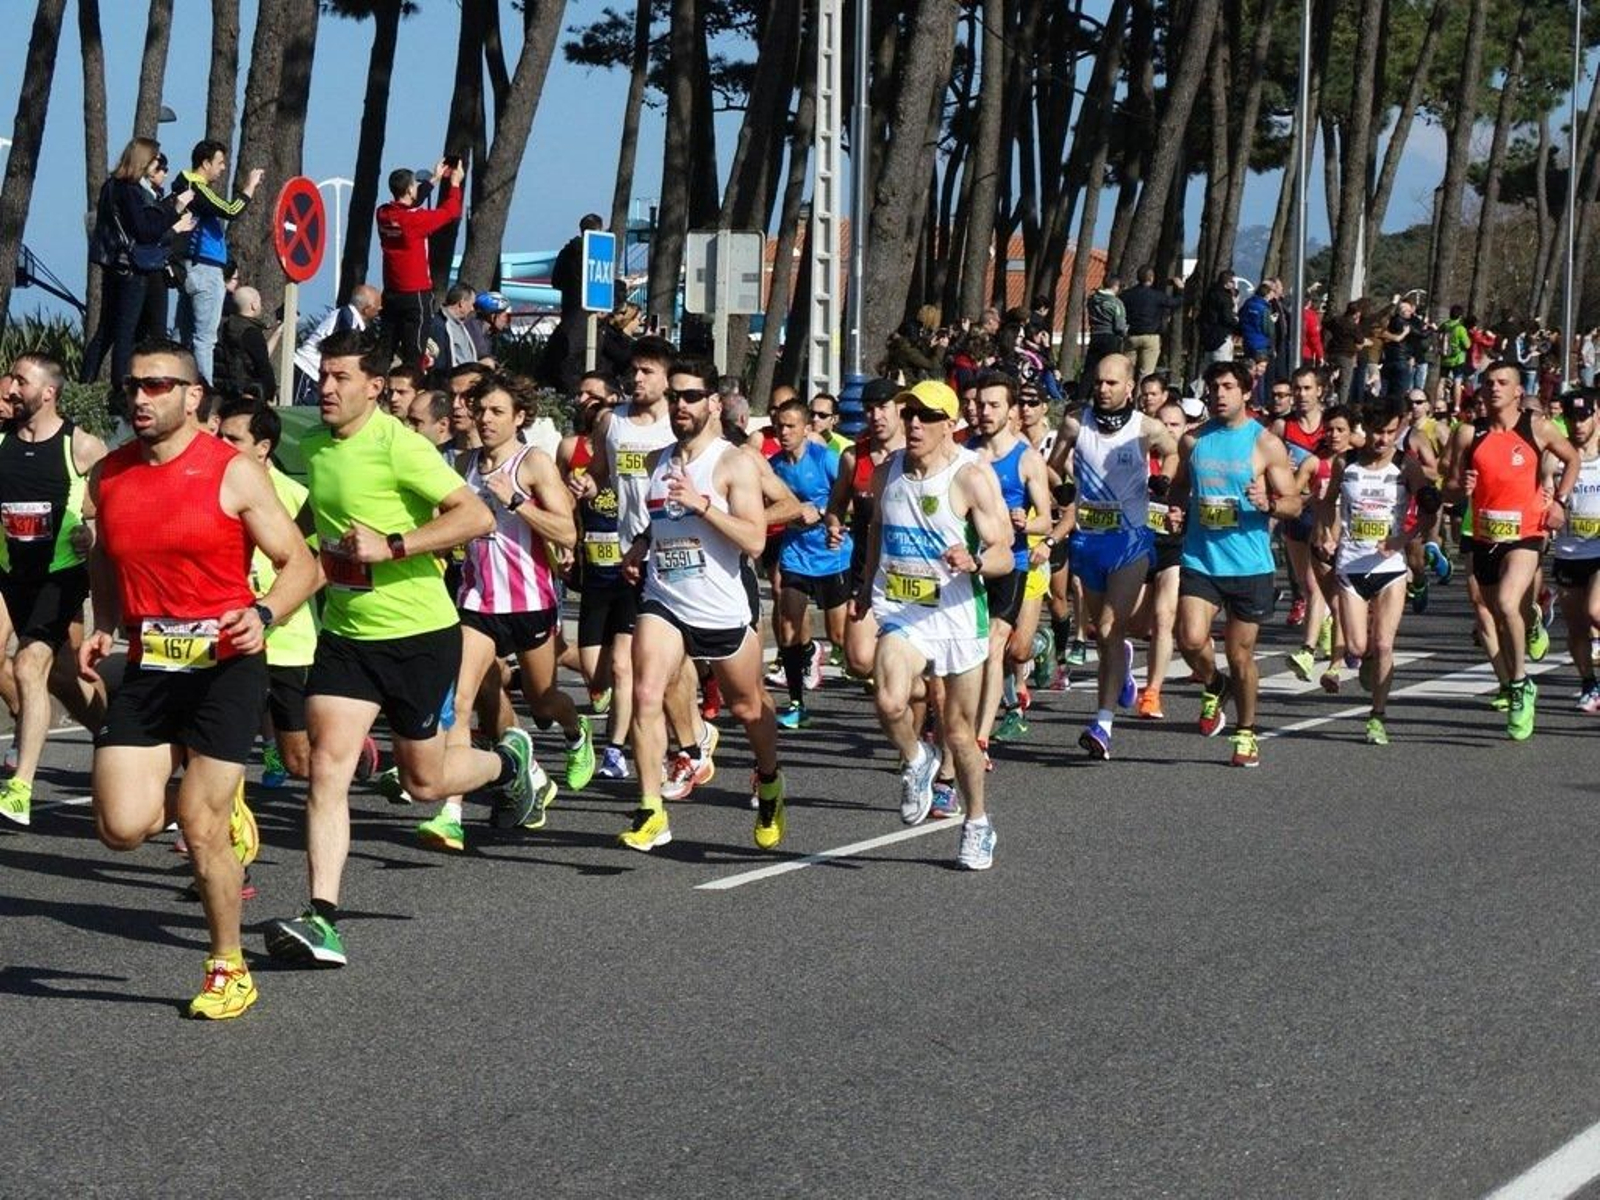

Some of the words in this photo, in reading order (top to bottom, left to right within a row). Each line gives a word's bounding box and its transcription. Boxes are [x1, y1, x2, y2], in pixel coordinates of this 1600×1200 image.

[588, 258, 614, 285] TAXI
[1354, 521, 1386, 537] 4096
[597, 543, 614, 560] 88
[664, 551, 693, 569] 5591
[901, 578, 921, 597] 115
[163, 637, 195, 660] 167
